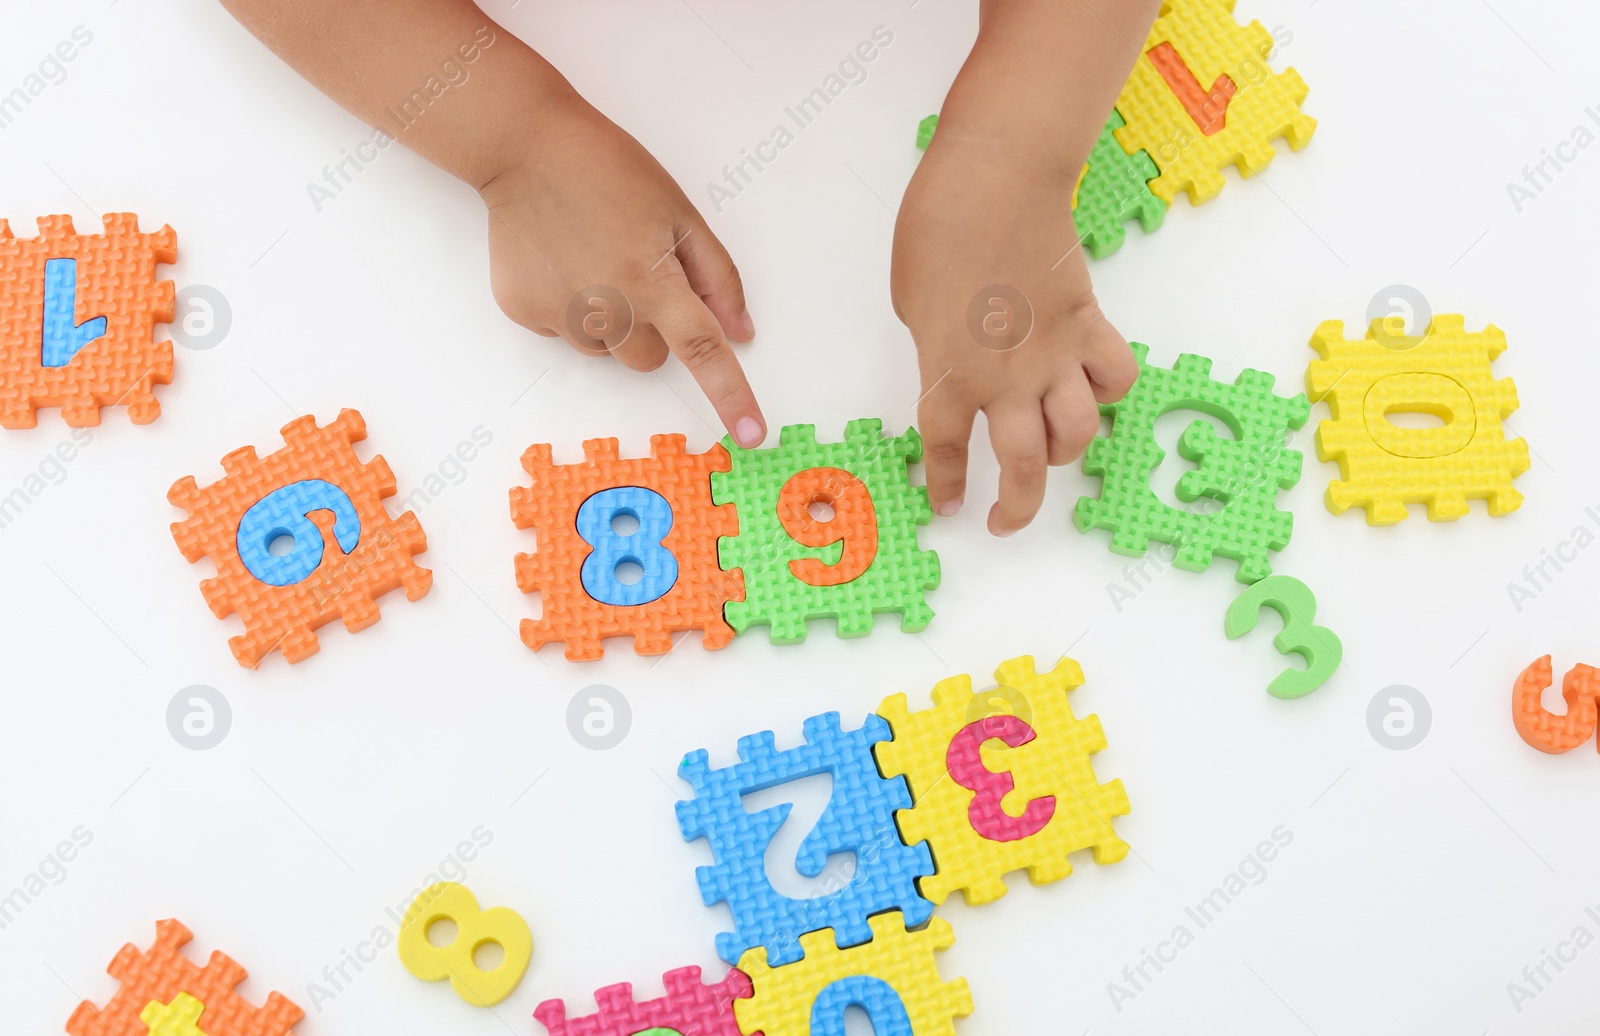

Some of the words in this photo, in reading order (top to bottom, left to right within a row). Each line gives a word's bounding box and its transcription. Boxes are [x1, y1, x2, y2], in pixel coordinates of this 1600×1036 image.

[1146, 40, 1237, 136] 1
[41, 257, 107, 367] 1
[576, 485, 679, 606] 8
[1225, 575, 1343, 699] 3
[946, 715, 1056, 842] 3
[398, 881, 533, 1007] 8
